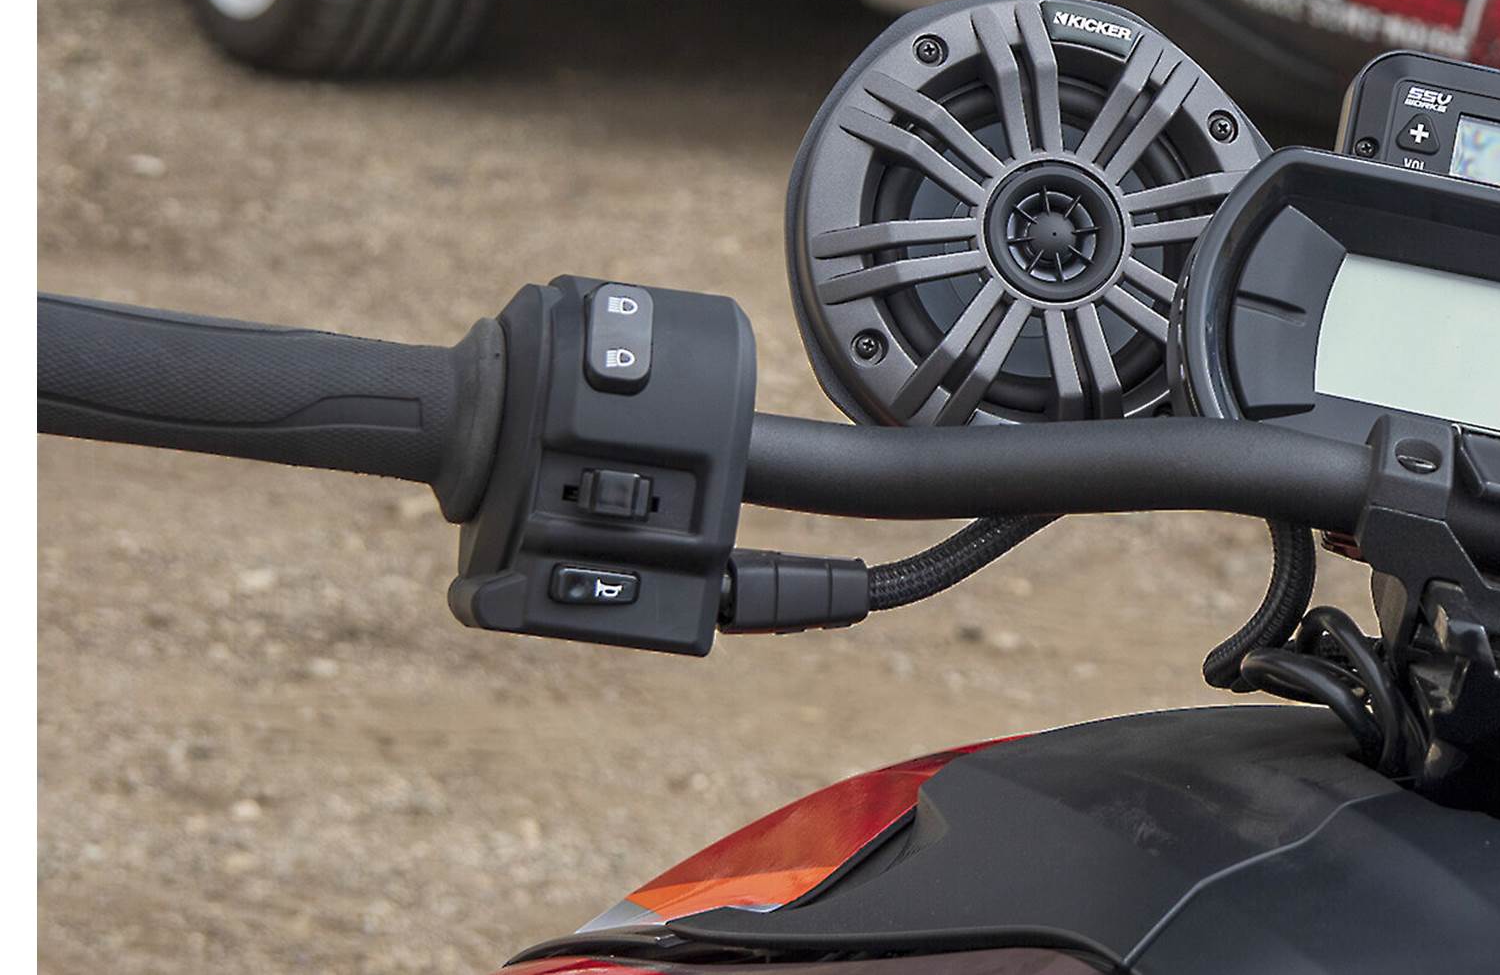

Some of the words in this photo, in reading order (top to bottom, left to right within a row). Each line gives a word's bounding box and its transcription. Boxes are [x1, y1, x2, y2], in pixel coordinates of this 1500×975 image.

[1070, 13, 1132, 41] KICKER
[1407, 86, 1453, 105] SSV
[1404, 98, 1448, 113] WORKS
